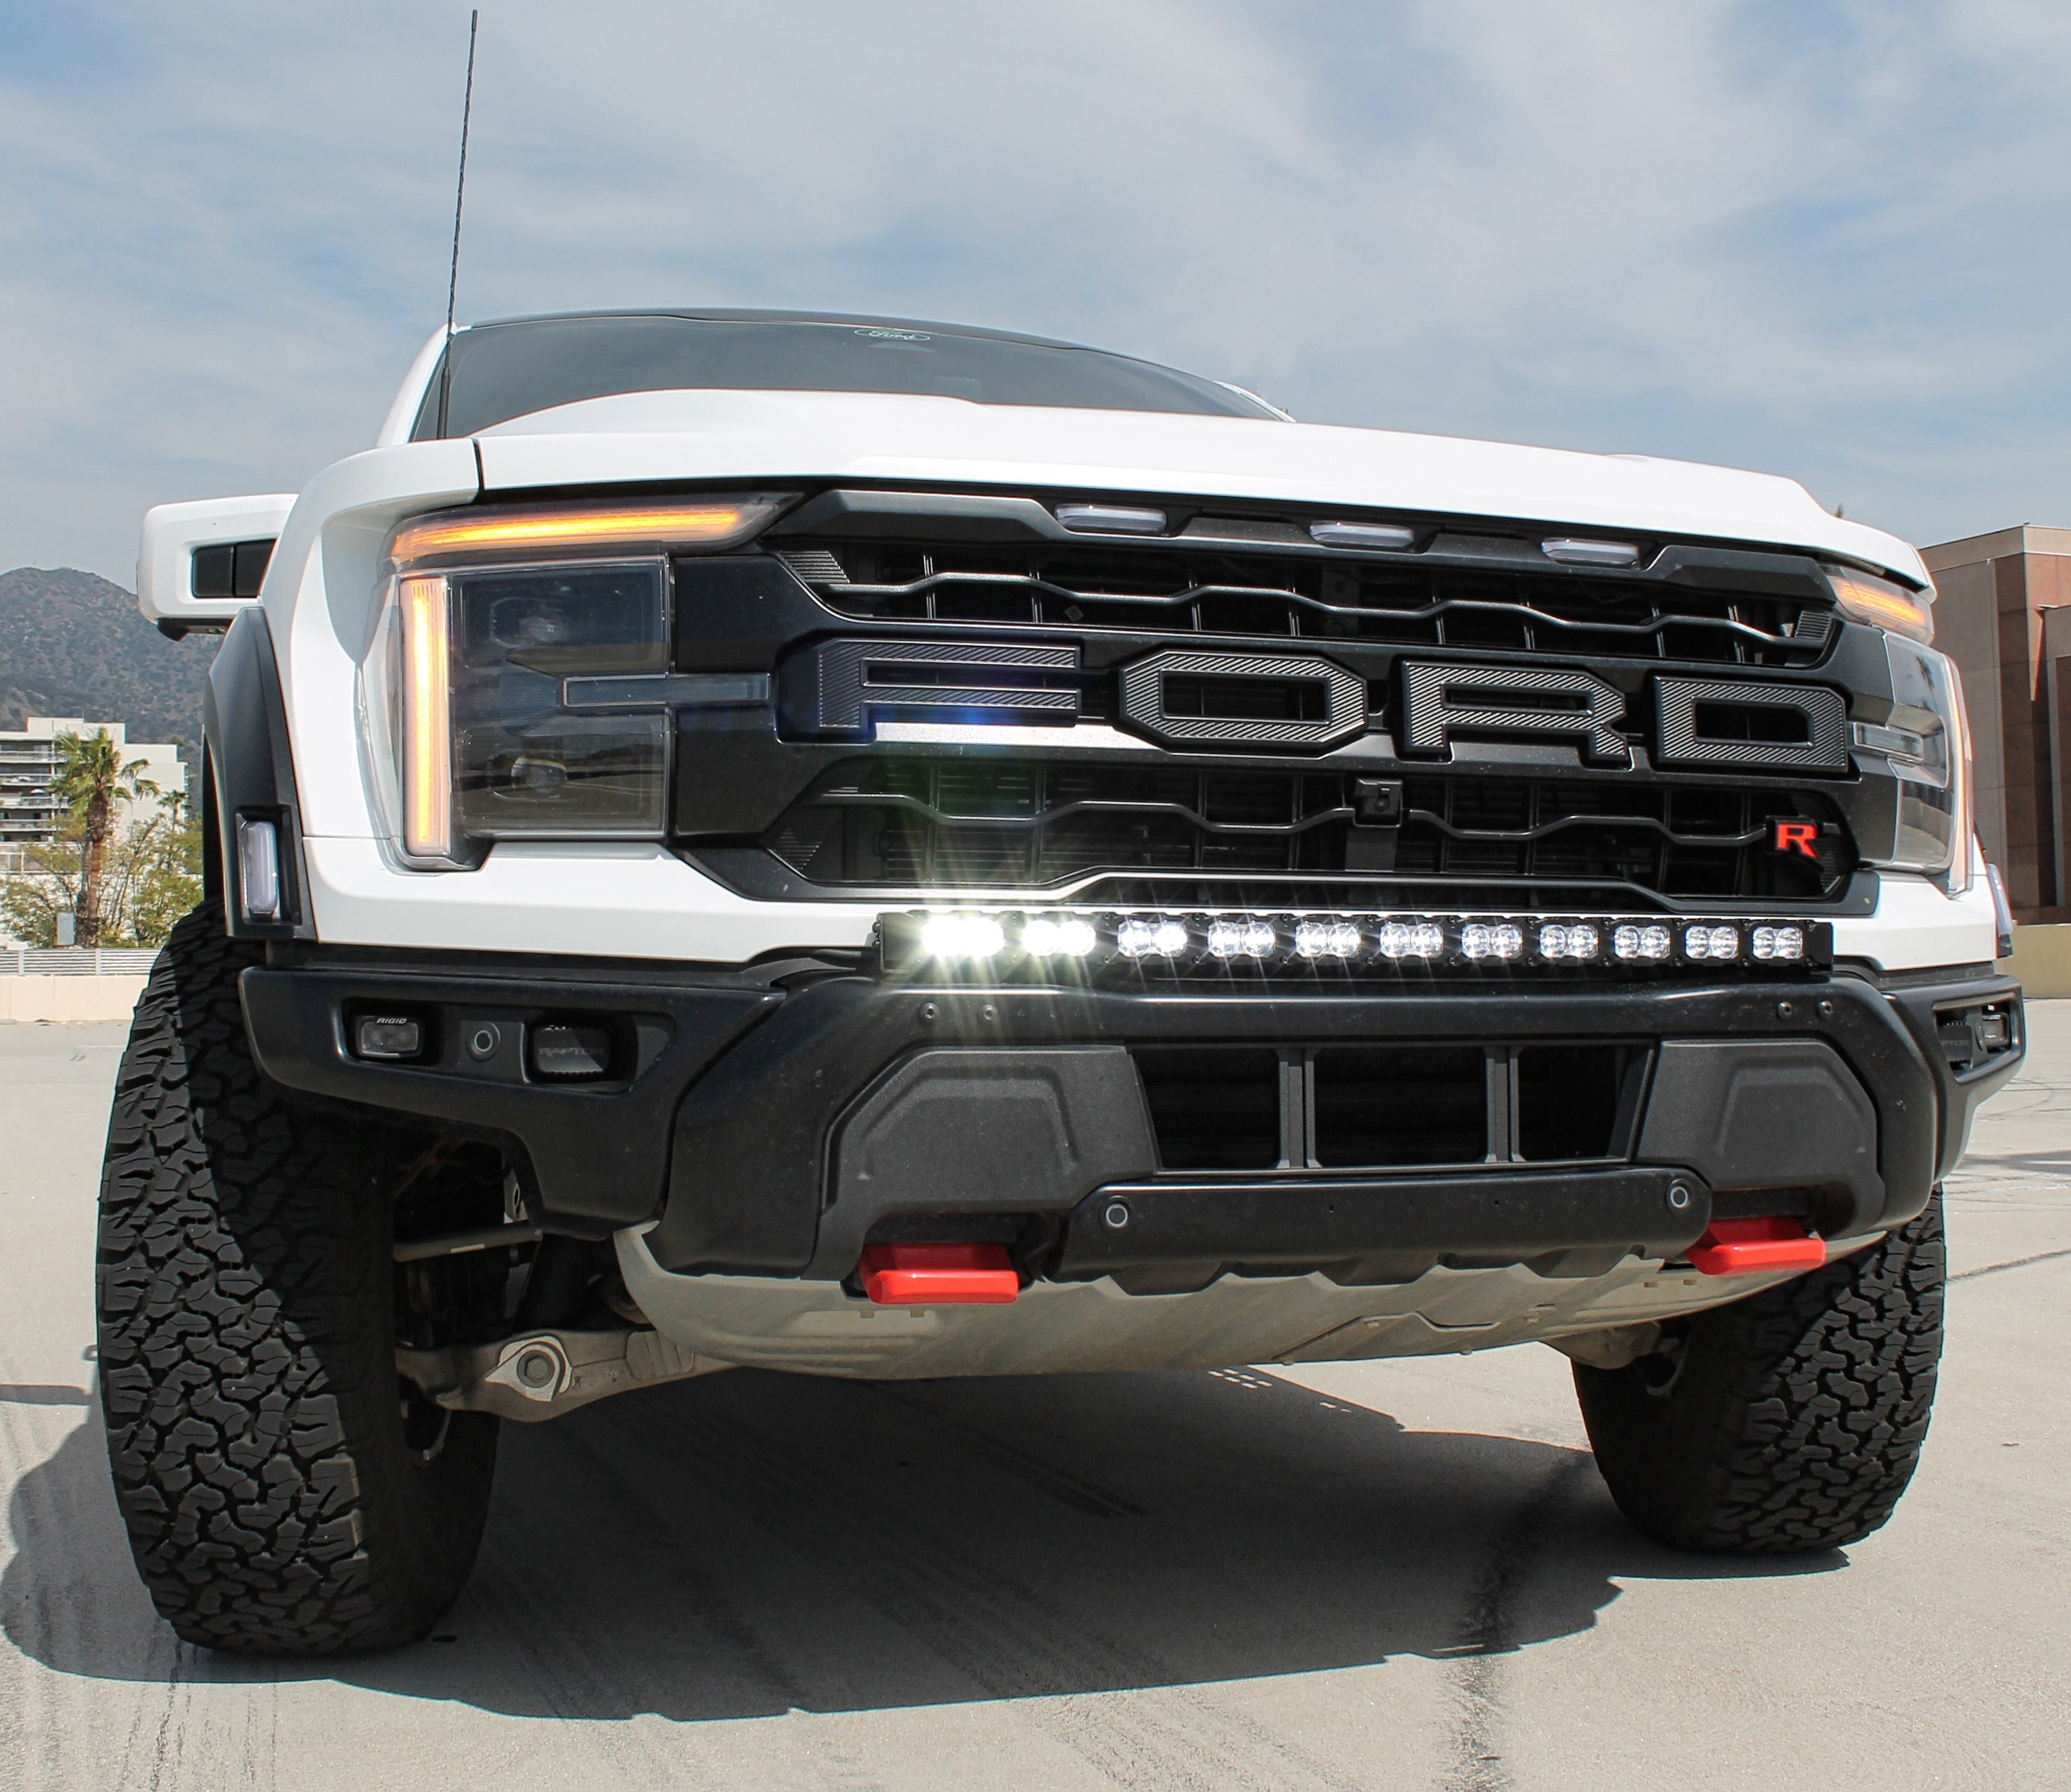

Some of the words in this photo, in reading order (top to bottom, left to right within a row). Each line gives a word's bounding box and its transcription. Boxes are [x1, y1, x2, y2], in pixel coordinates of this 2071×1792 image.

[869, 330, 917, 341] Ford
[818, 639, 1848, 773] FORD
[1776, 822, 1819, 859] R
